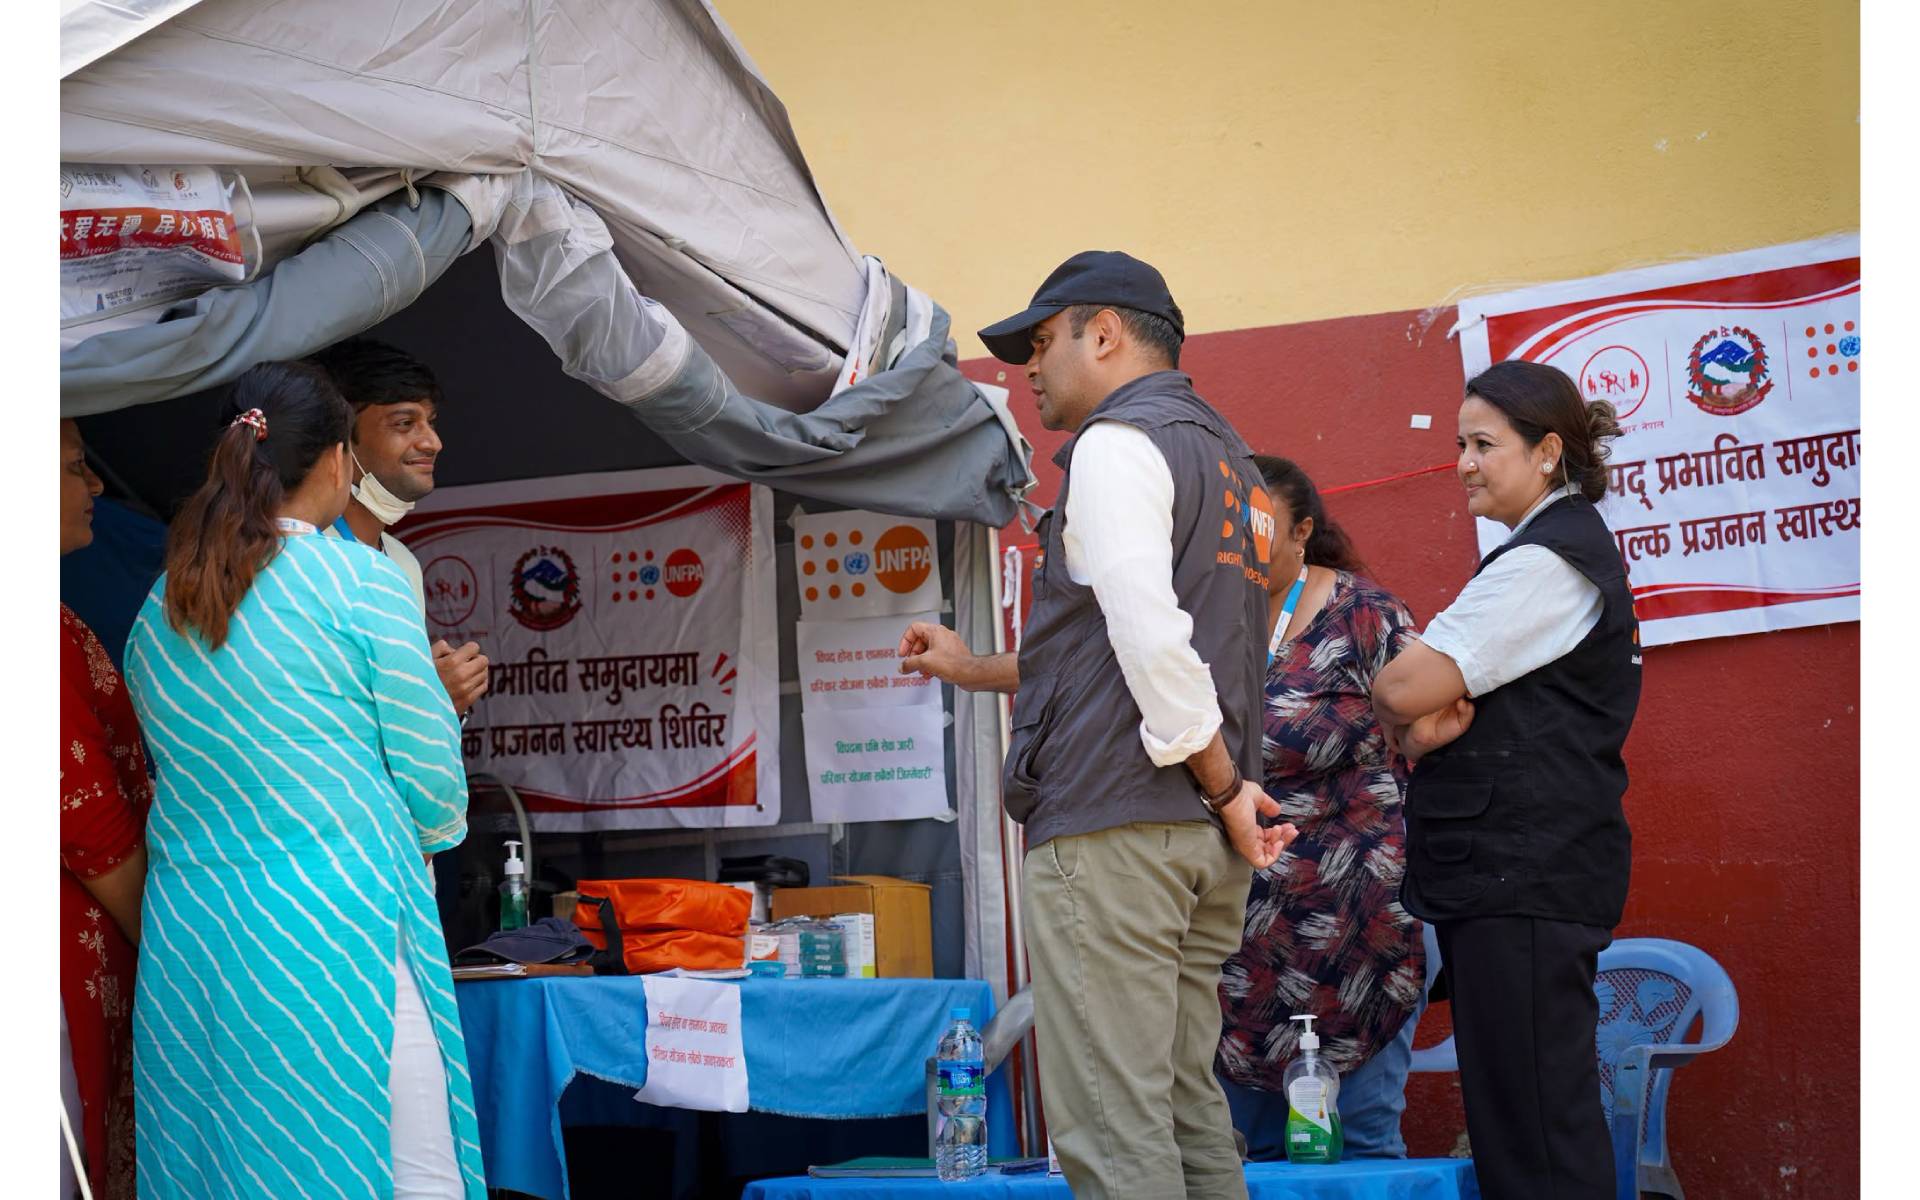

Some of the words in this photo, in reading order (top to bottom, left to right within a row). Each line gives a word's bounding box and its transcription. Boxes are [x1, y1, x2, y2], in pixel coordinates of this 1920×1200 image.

[1656, 433, 1766, 494] प्रभावित
[1773, 429, 1860, 488] समुदा
[1679, 510, 1766, 556] प्रजनन
[663, 563, 704, 583] UNFPA
[577, 651, 699, 706] समुदायमा
[490, 722, 566, 758] प्रजनन
[572, 717, 653, 754] स्वास्थ्य
[659, 702, 728, 751] शिविर
